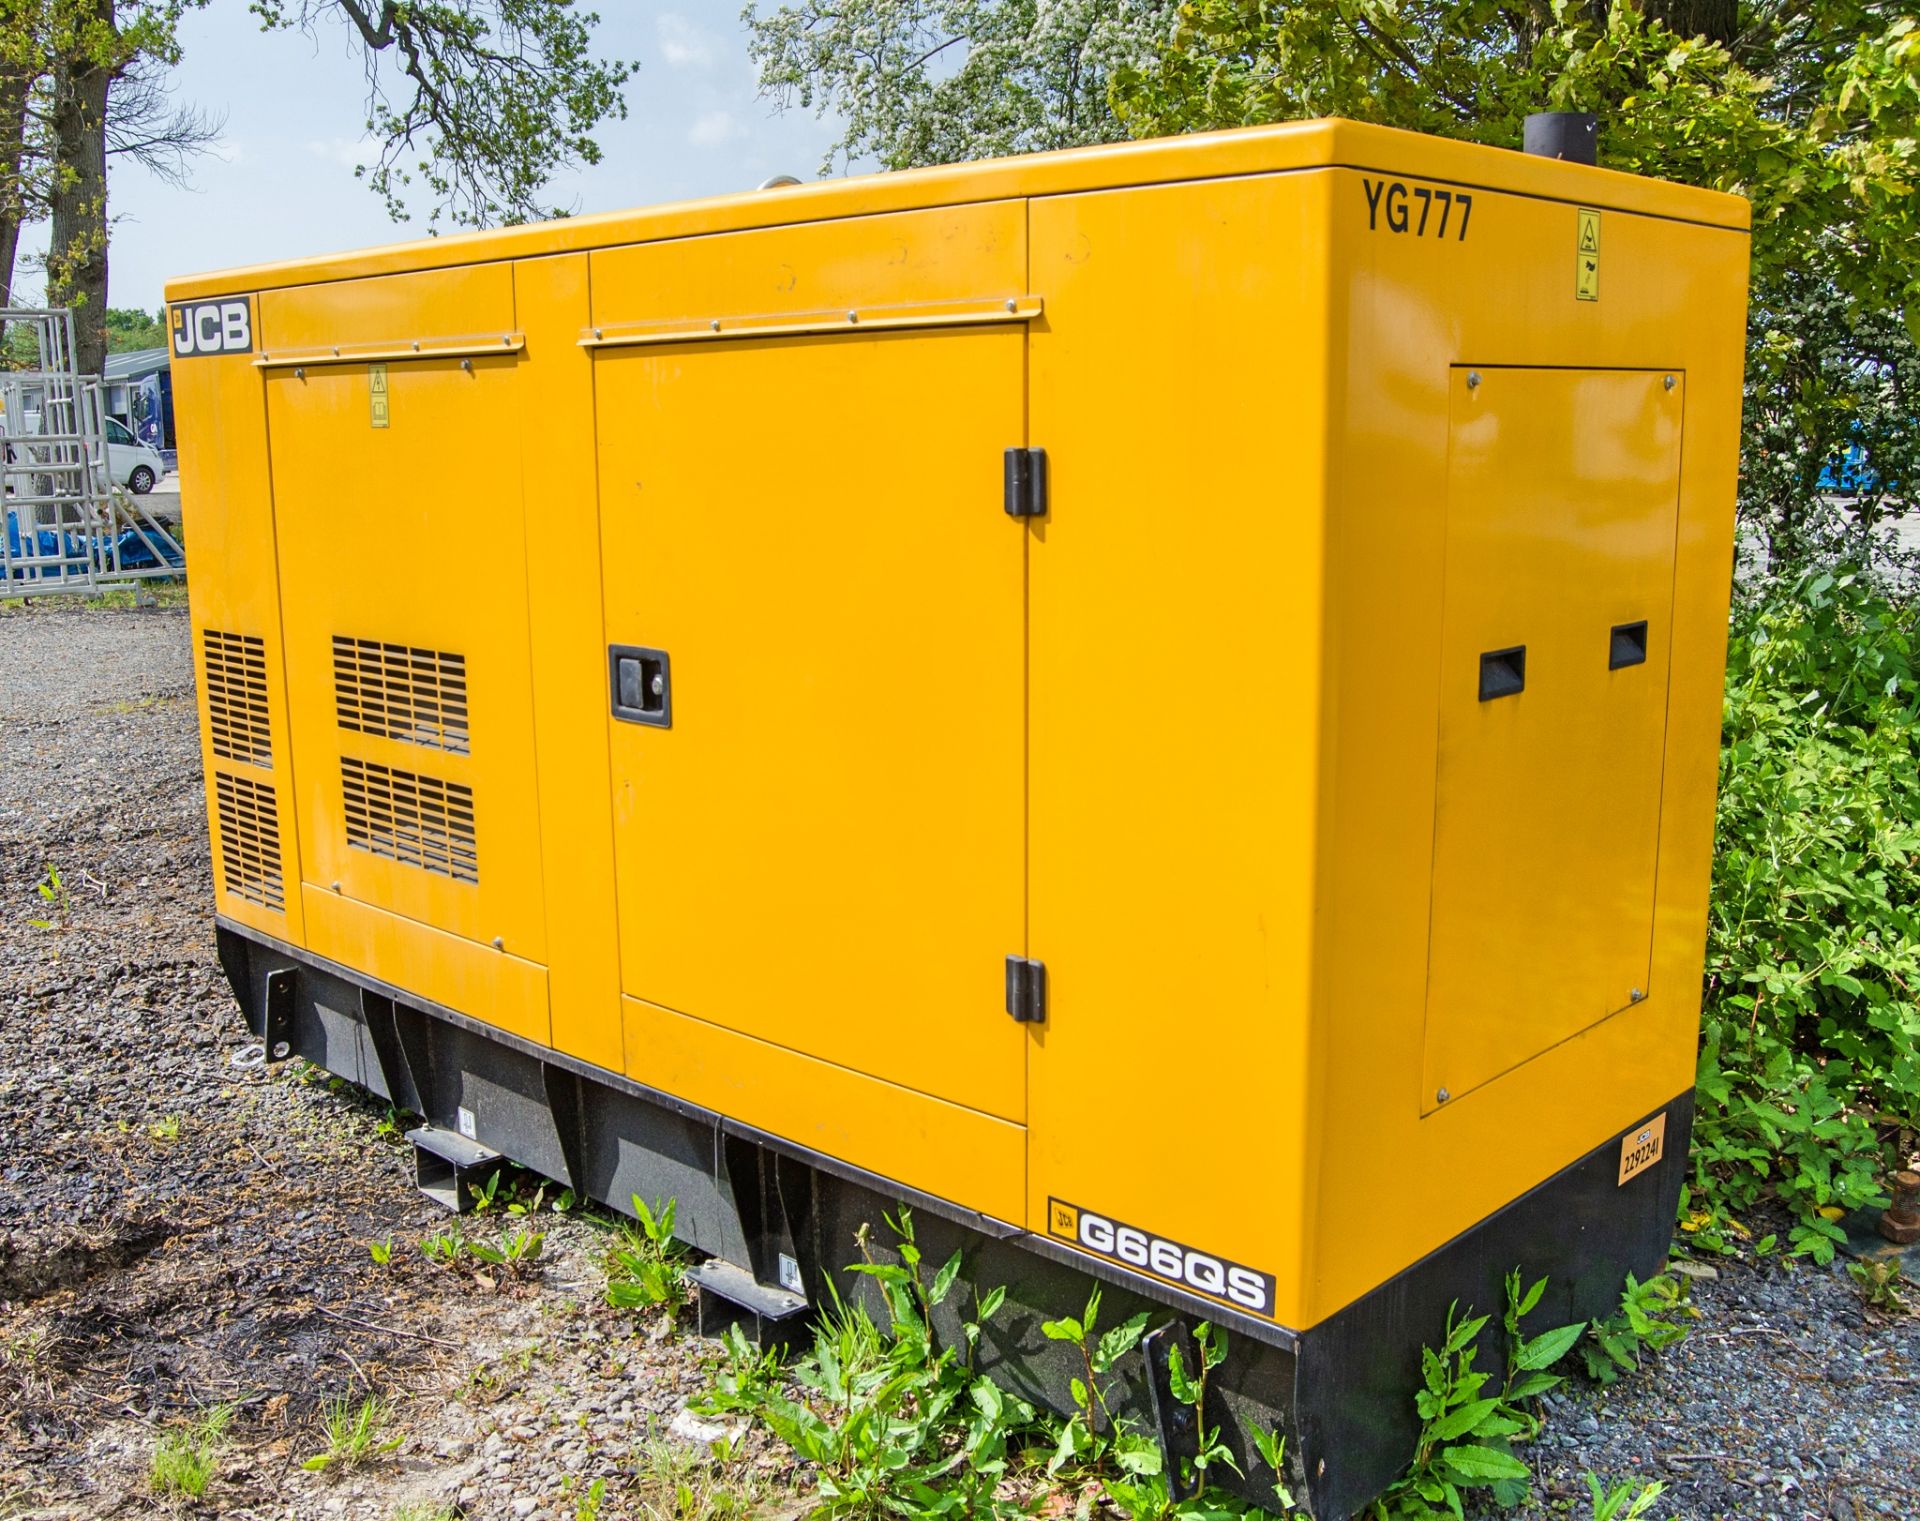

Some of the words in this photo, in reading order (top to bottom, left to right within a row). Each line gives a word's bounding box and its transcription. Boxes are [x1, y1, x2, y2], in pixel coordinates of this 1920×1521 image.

[1363, 178, 1472, 241] YG777
[174, 302, 250, 354] JCB
[1624, 1136, 1660, 1175] 2292241
[1080, 1213, 1266, 1310] G66QS
